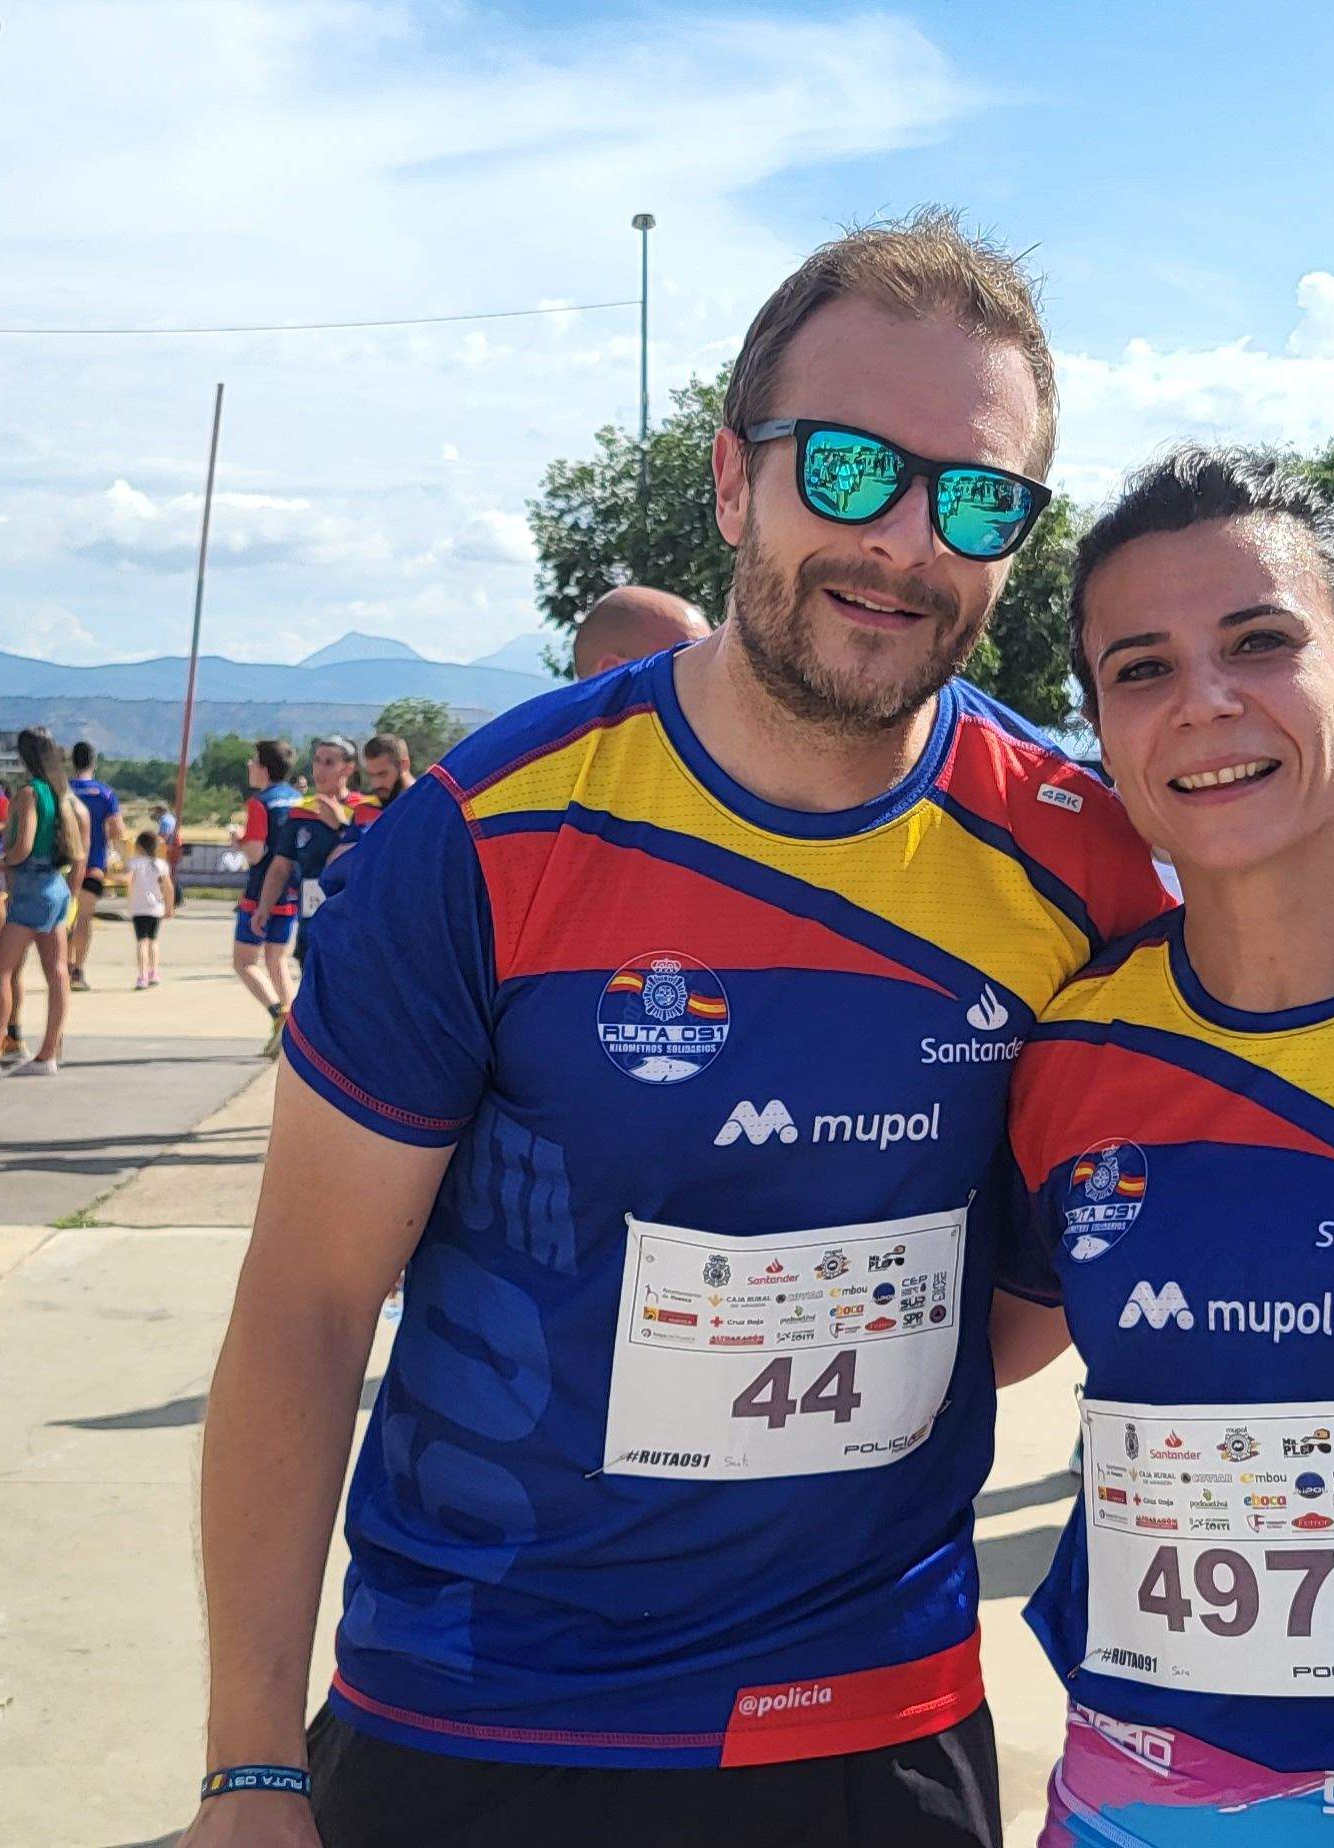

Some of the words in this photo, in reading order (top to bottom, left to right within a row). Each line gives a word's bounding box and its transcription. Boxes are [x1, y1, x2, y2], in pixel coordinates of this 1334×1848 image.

[1042, 790, 1079, 809] 42K
[603, 1025, 670, 1041] RUTA
[681, 1026, 725, 1041] 091
[609, 1043, 663, 1053] KILOMETROS
[666, 1044, 717, 1054] SOLIDARIOS
[920, 1037, 1024, 1065] Santande
[812, 1103, 940, 1150] mupol
[747, 1274, 799, 1286] Santander
[901, 1275, 927, 1287] CEP
[900, 1296, 926, 1309] SUR
[747, 1318, 764, 1326] Roja
[1208, 1291, 1333, 1342] mupol
[731, 1349, 862, 1430] 44
[1226, 1425, 1247, 1434] mupol
[626, 1450, 710, 1469] #RUTA091
[1149, 1449, 1202, 1461] Santander
[1244, 1493, 1287, 1506] eboca
[1101, 1647, 1158, 1674] #RUTA091
[739, 1685, 833, 1716] @policia
